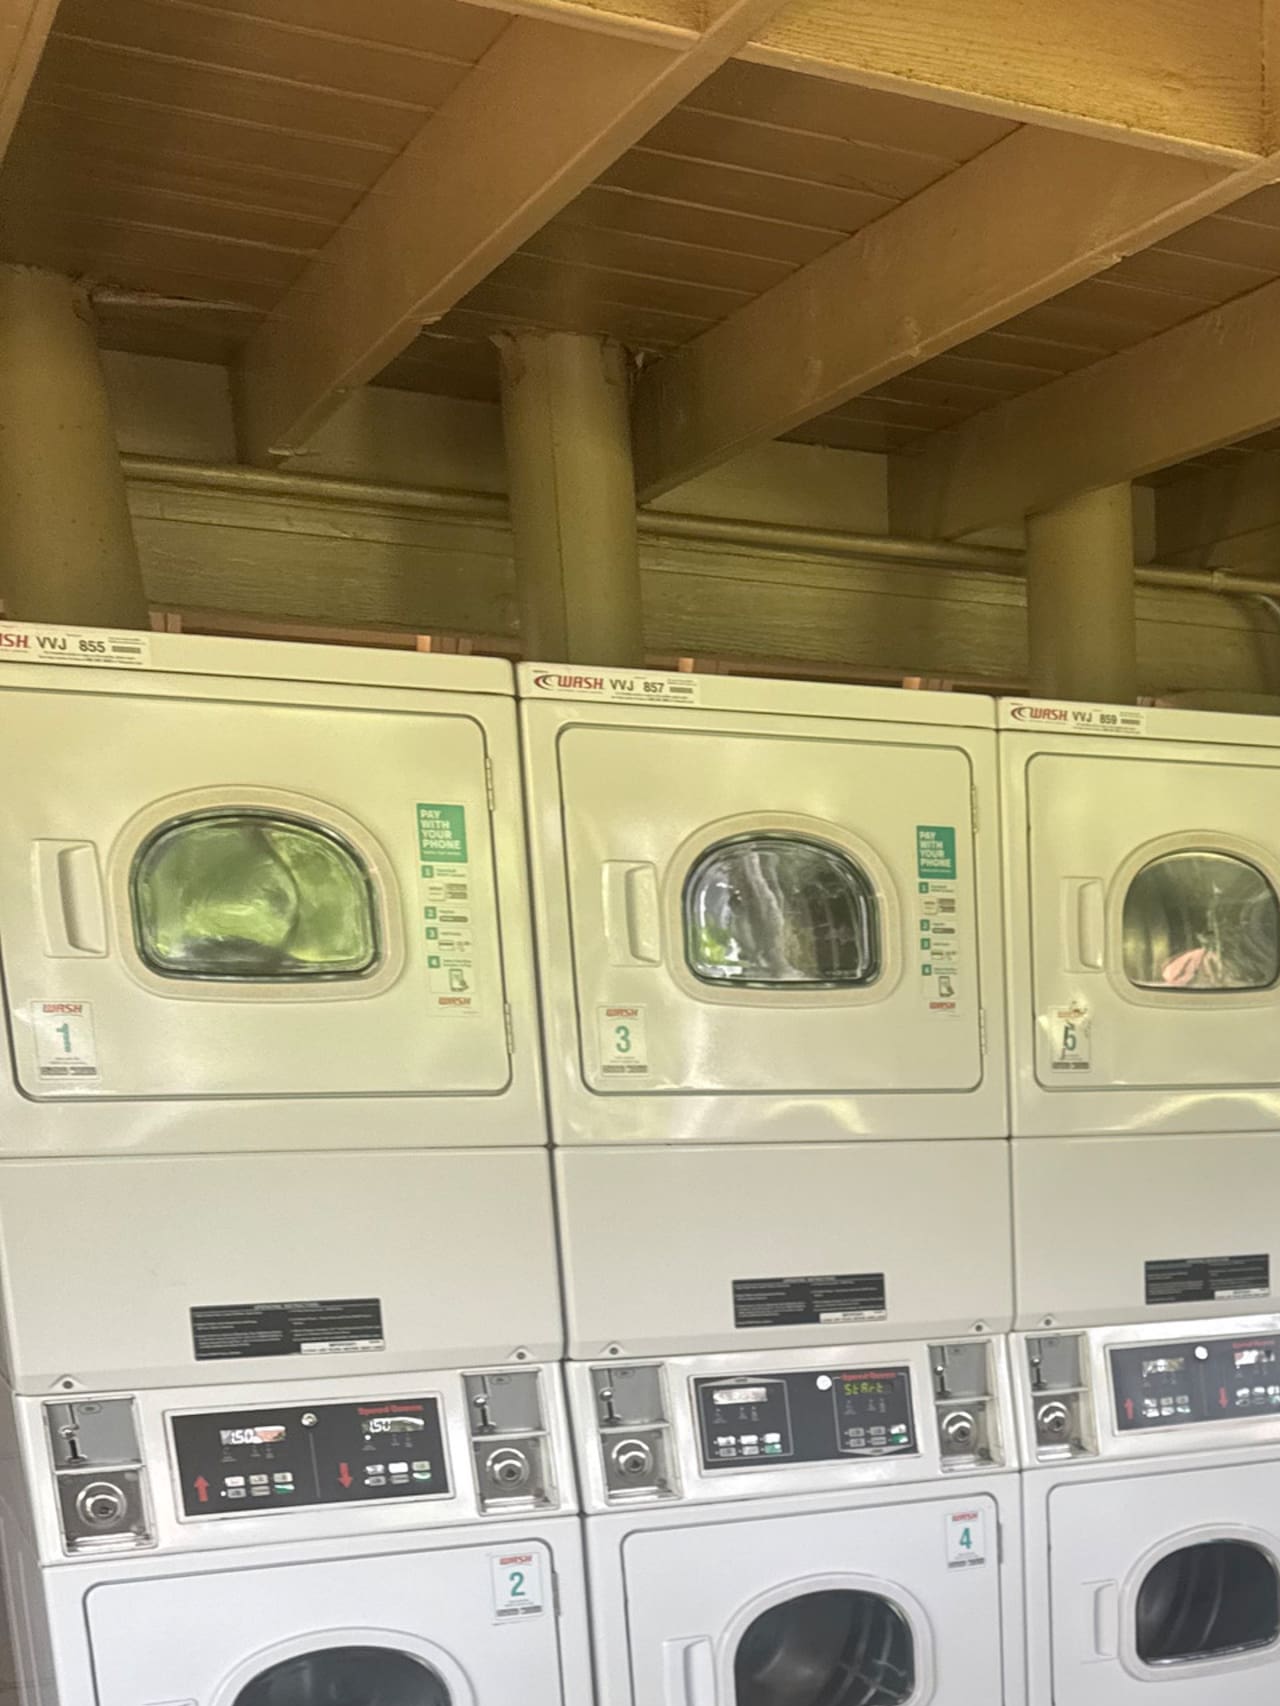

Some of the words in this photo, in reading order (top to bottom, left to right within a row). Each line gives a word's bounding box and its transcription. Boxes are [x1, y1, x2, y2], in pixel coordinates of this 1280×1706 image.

[557, 675, 604, 690] WASH
[643, 682, 664, 693] 857
[1030, 707, 1068, 720] WASH
[422, 830, 452, 840] YOUR
[422, 840, 462, 849] PHONE
[56, 1023, 71, 1053] 1
[615, 1025, 631, 1053] 3
[959, 1527, 972, 1549] 4
[509, 1571, 526, 1597] 2
